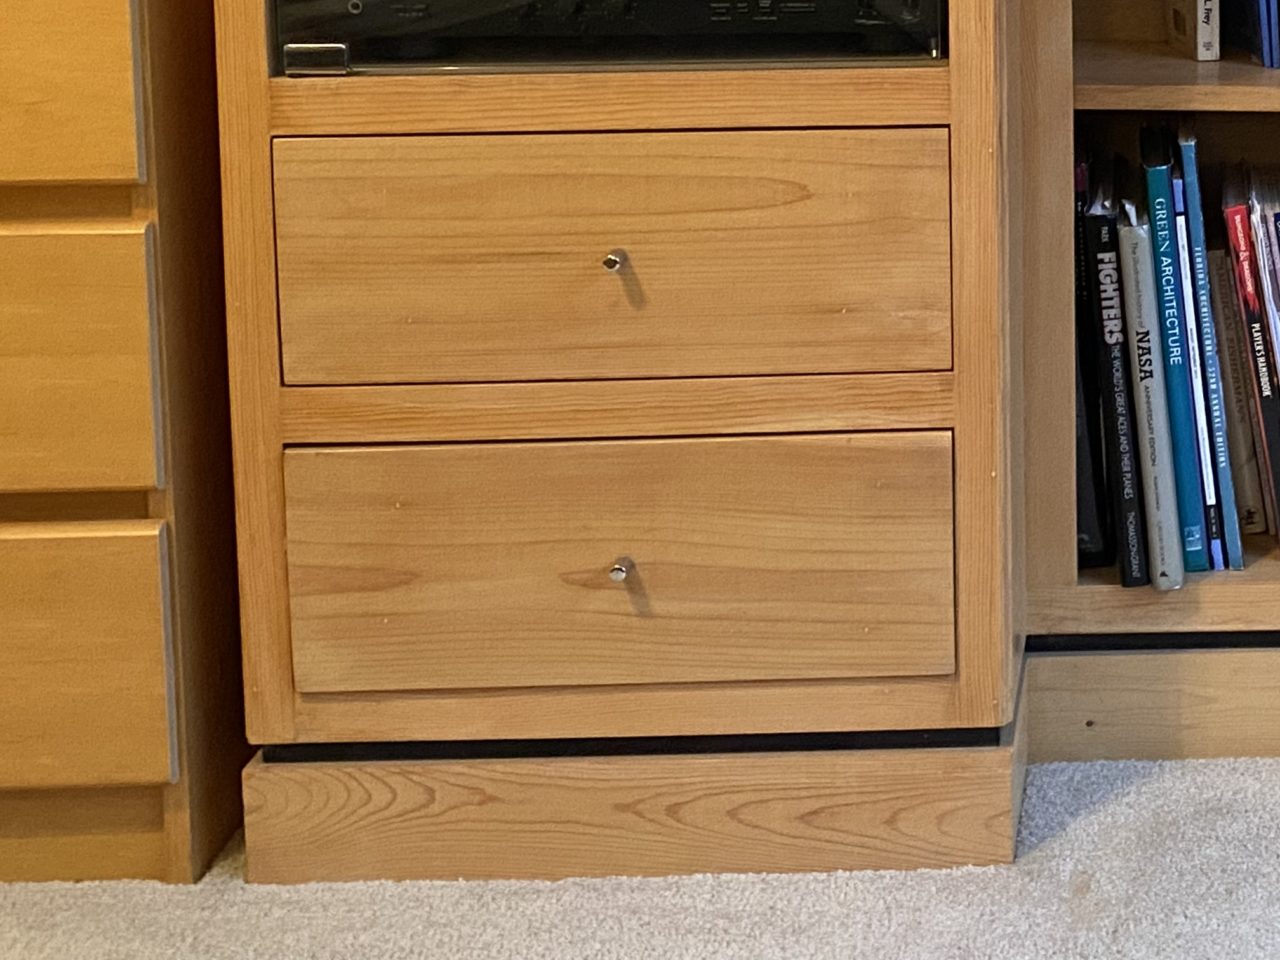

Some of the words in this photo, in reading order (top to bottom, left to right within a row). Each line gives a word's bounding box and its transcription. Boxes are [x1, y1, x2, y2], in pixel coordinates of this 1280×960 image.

[1201, 8, 1213, 26] Frey
[1154, 197, 1172, 253] GREEN
[1130, 242, 1140, 256] The
[1194, 246, 1206, 286] FLORIDA
[1238, 250, 1249, 262] &
[1097, 250, 1125, 345] FIGHTERS
[1135, 294, 1146, 320] history
[1160, 255, 1183, 366] ARCHITECTURE
[1199, 289, 1214, 357] ARCHITECTURE
[1251, 322, 1265, 357] PLAYER'S
[1111, 344, 1122, 360] THE
[1136, 329, 1154, 383] NASA
[1216, 266, 1234, 331] AMERICAN
[1229, 337, 1247, 424] FISHERMAN
[1111, 359, 1124, 392] WORLD'S
[1256, 356, 1271, 398] HANDBOOK
[1114, 391, 1127, 415] GREAT
[1143, 384, 1154, 436] ANNIVERSARY
[1209, 393, 1221, 429] ANNUAL
[1117, 415, 1128, 435] ACES
[1119, 435, 1130, 453] AND
[1148, 436, 1157, 467] EDITION
[1213, 431, 1226, 468] EDITION
[1120, 452, 1132, 473] THEIR
[1121, 472, 1134, 500] PLANES
